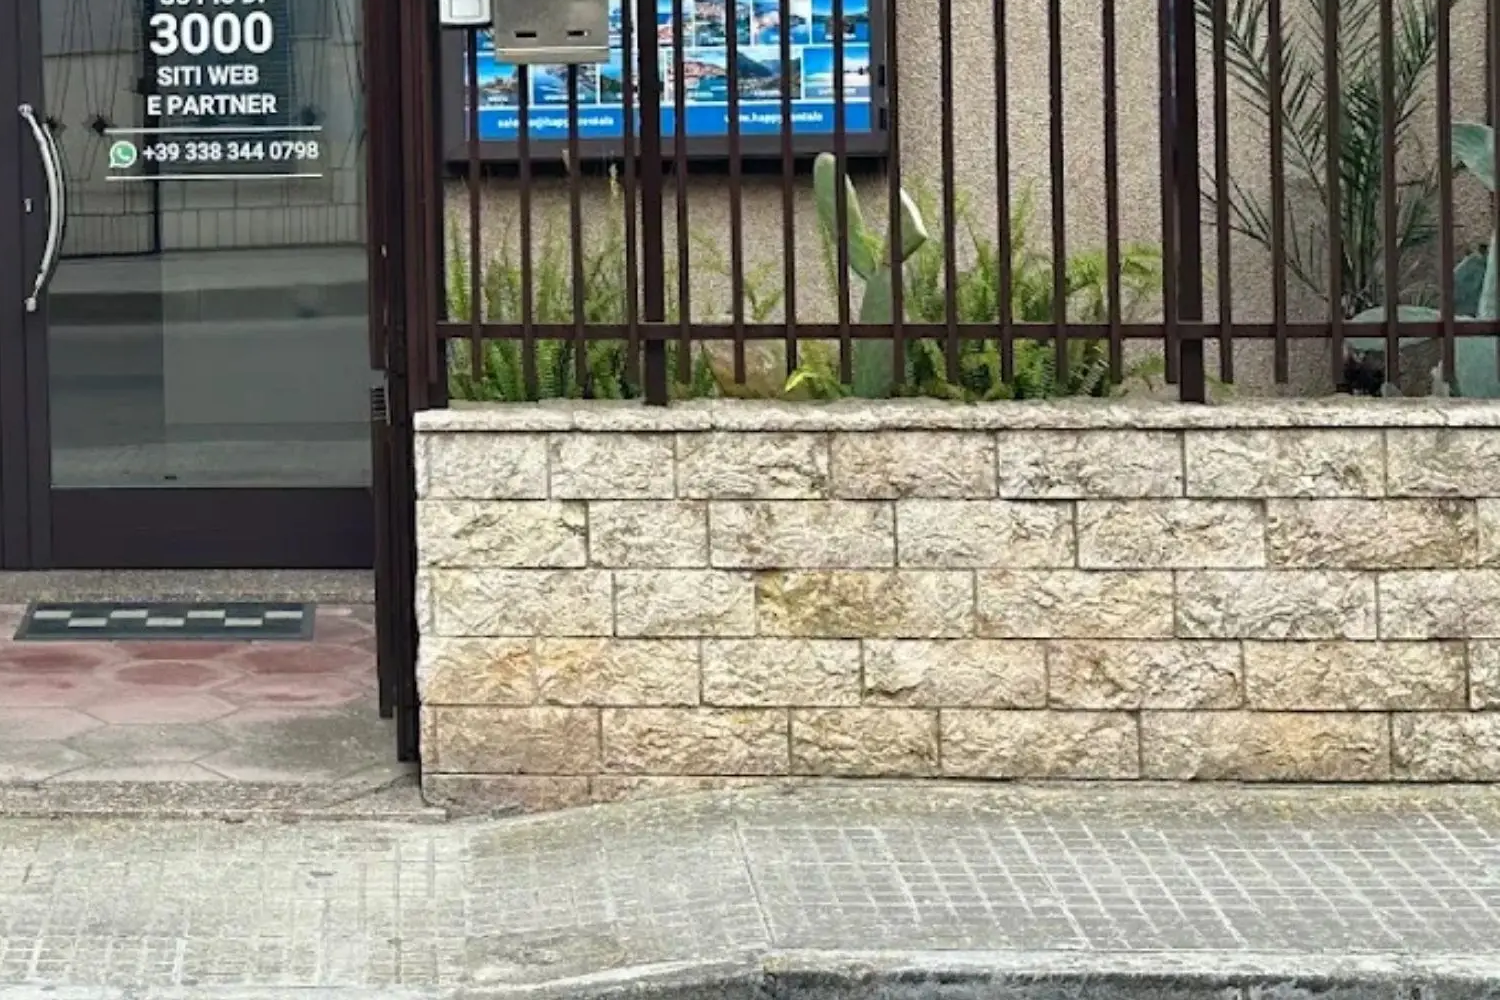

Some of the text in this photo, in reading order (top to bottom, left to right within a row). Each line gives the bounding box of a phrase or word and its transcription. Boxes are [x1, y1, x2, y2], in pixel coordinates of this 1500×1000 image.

[150, 10, 273, 56] 3000
[157, 65, 260, 86] SITI WEB
[147, 94, 277, 115] E PARTNER
[143, 140, 319, 161] +39 338 344 0798
